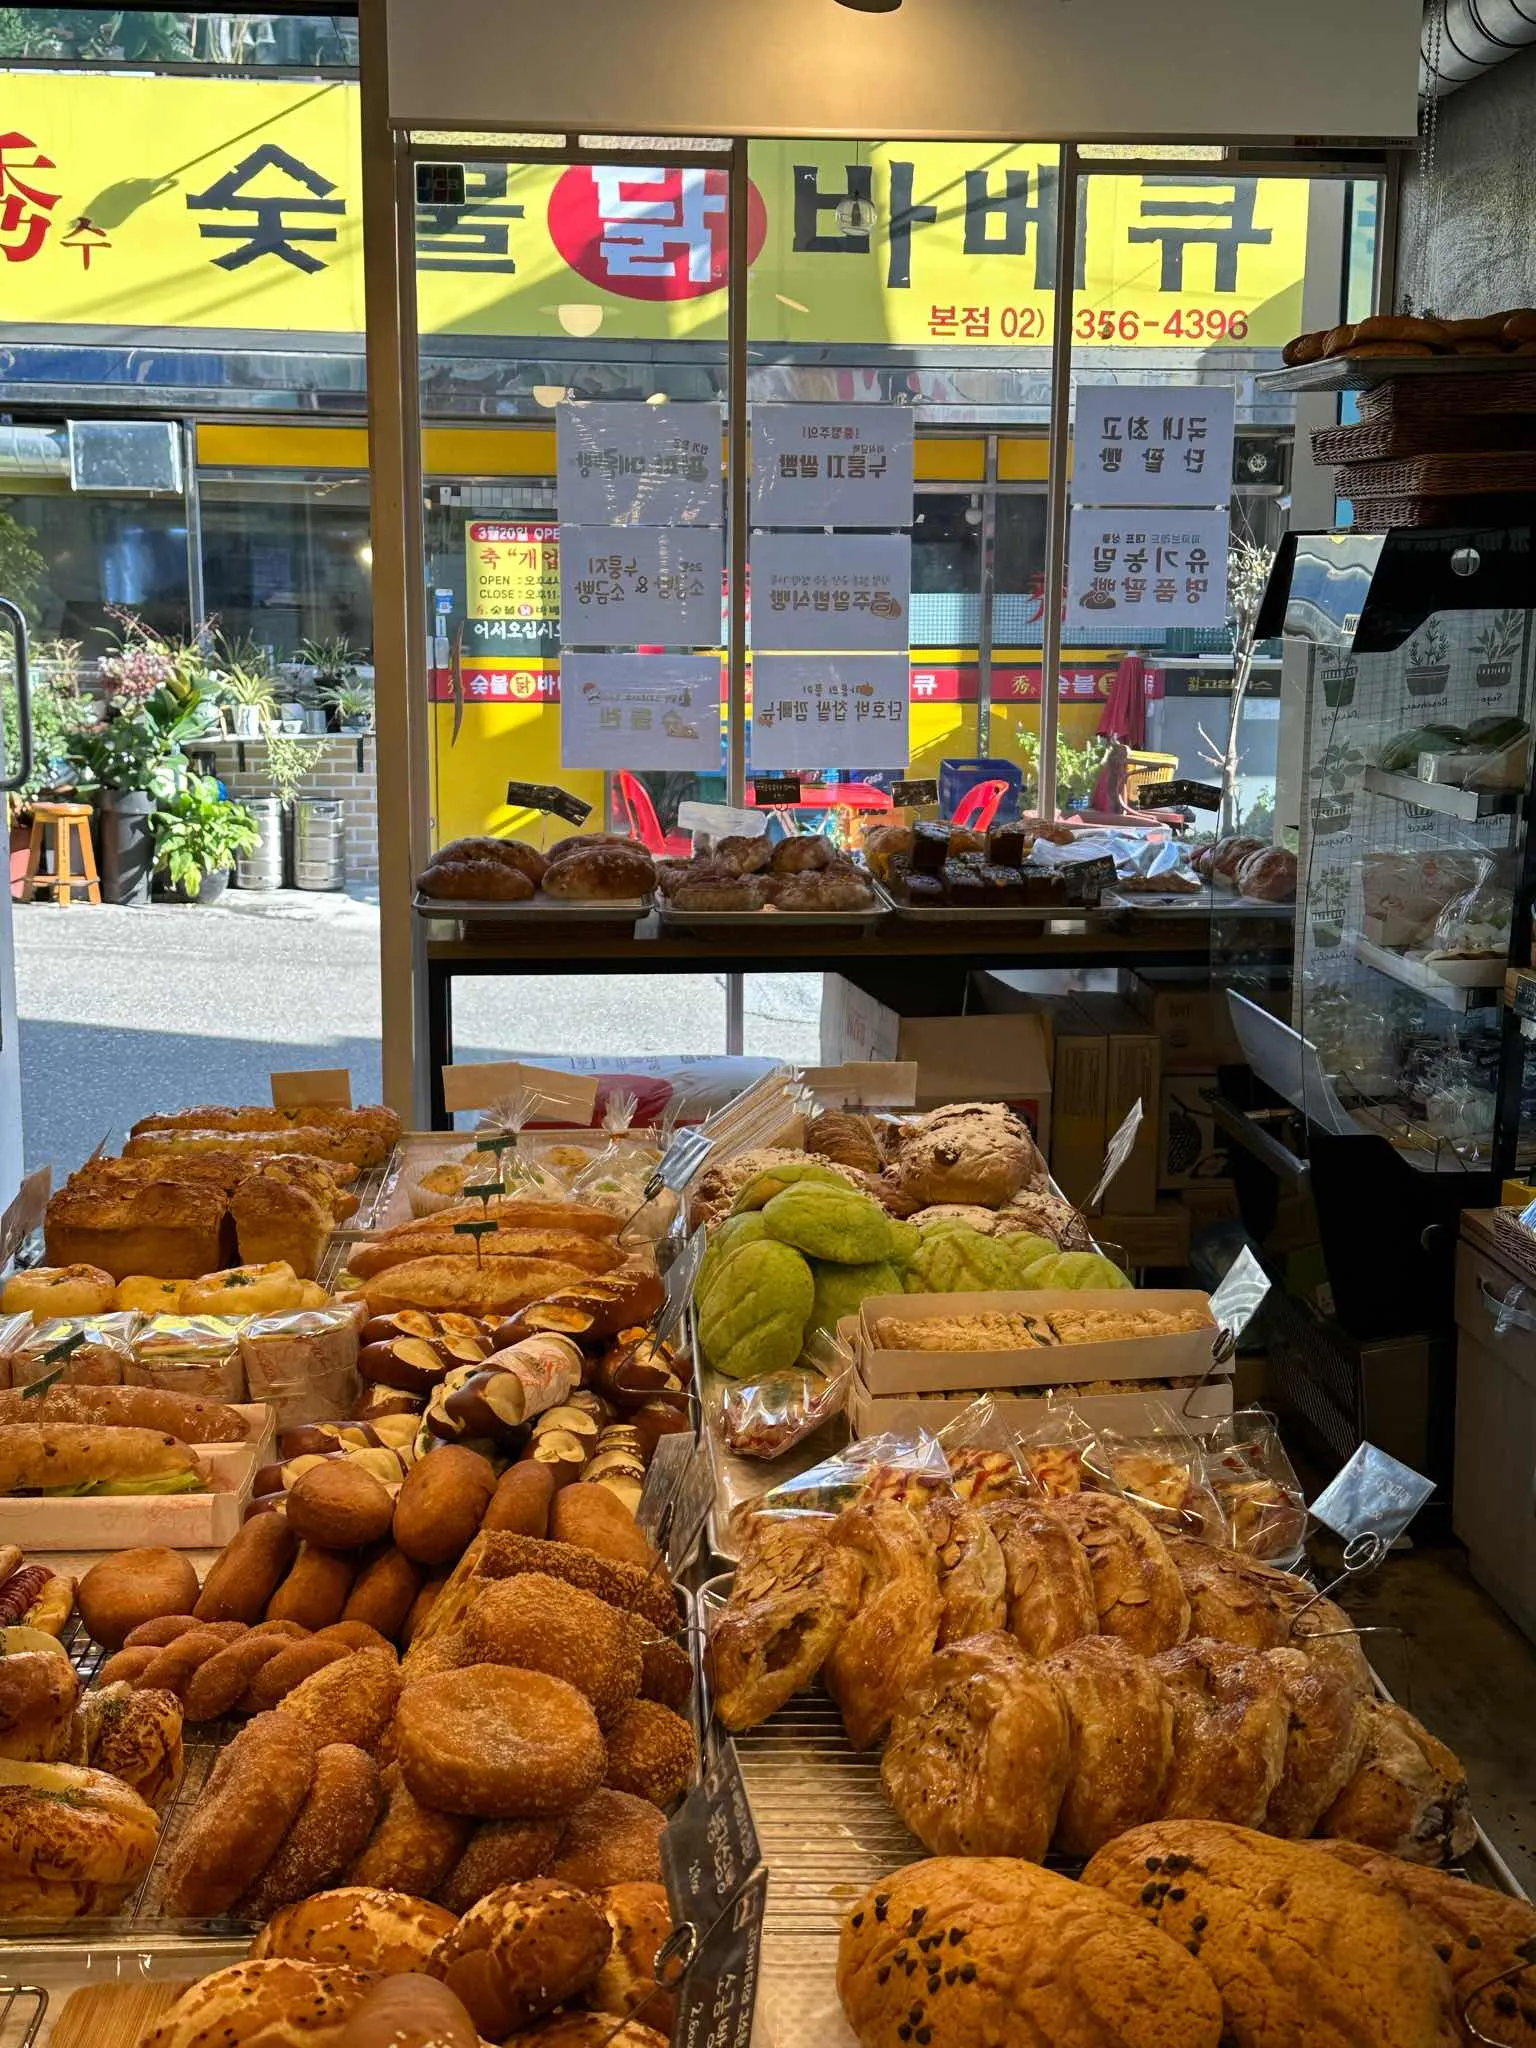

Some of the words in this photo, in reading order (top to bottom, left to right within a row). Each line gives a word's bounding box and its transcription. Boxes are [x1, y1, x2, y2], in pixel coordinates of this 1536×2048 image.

[927, 305, 990, 338] 본점
[479, 547, 501, 570] 축
[479, 575, 510, 585] OPEN
[479, 589, 515, 599] CLOSE
[912, 675, 938, 695] 큐
